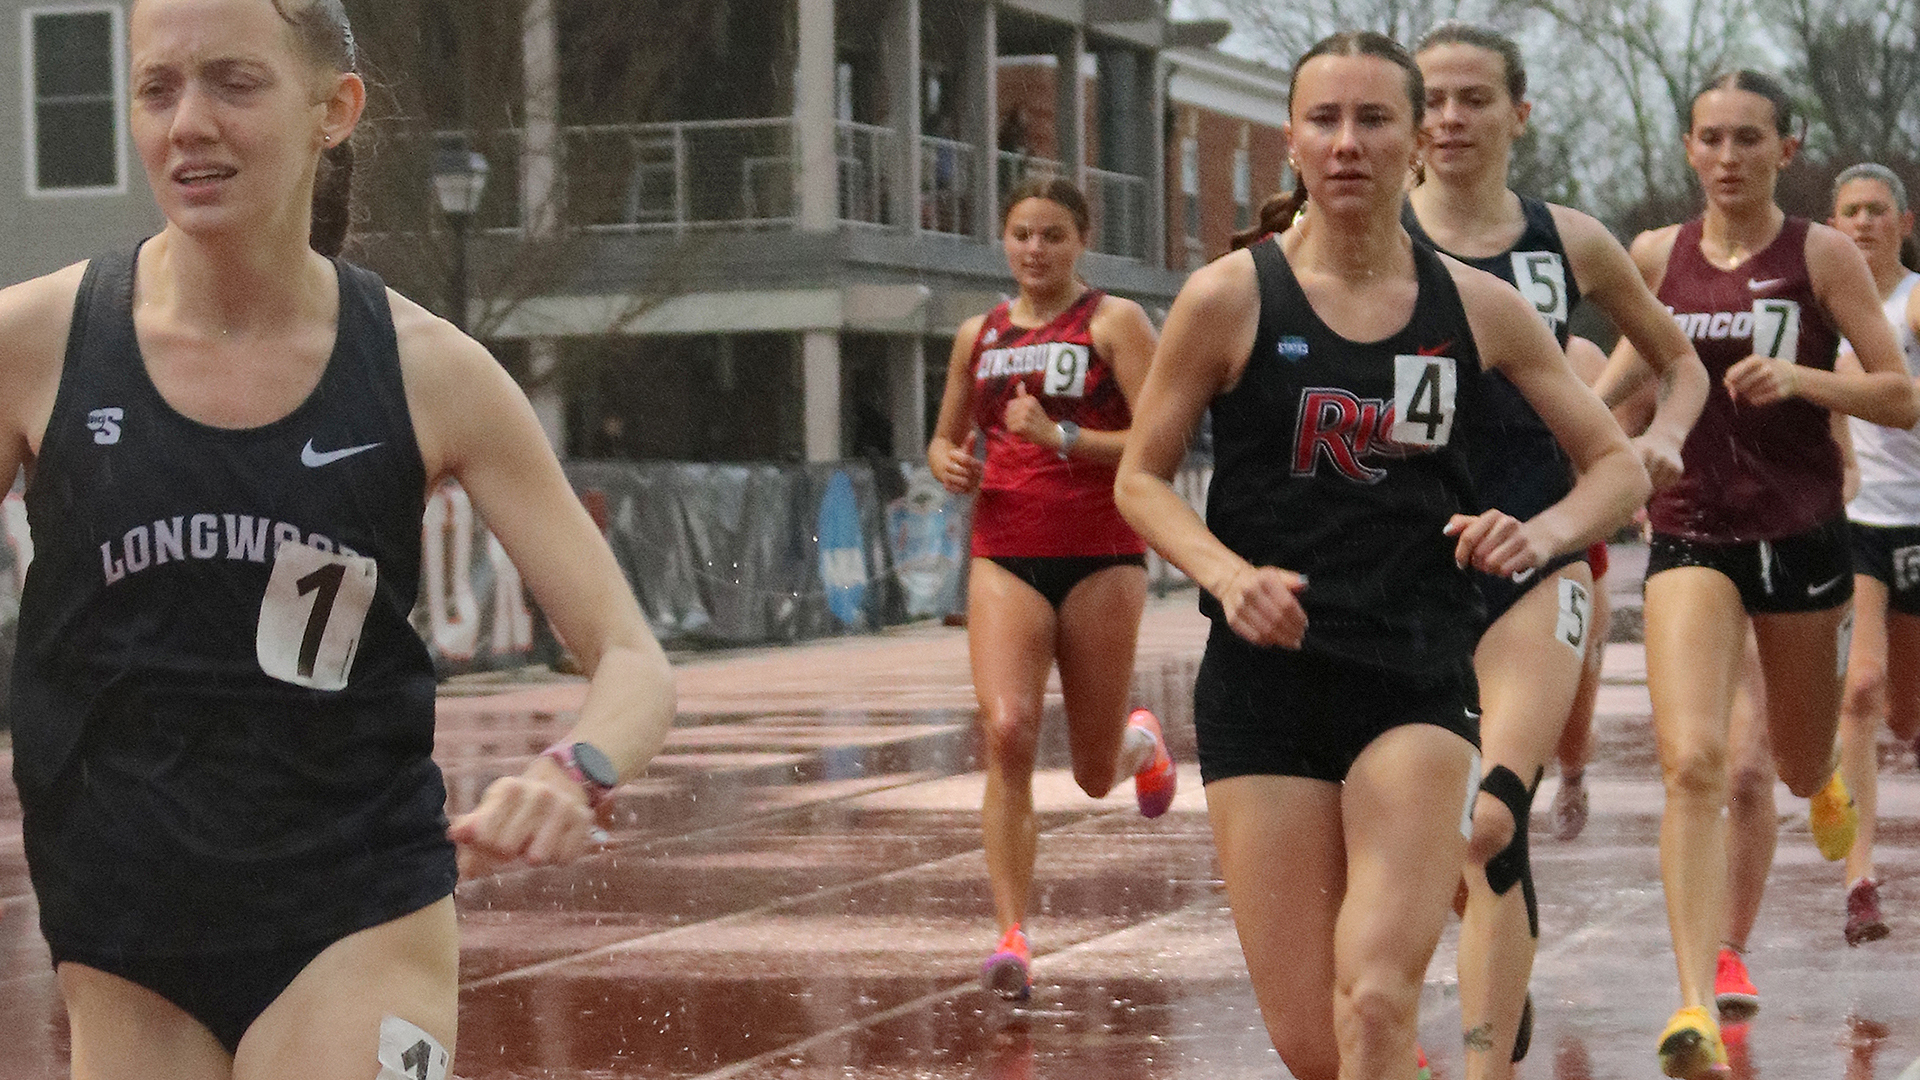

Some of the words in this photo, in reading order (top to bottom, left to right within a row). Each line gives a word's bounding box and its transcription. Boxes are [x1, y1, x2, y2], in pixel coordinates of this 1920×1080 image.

[1526, 256, 1558, 313] 5
[1765, 304, 1787, 358] 7
[1056, 349, 1077, 391] 9
[1406, 363, 1444, 440] 4
[1290, 387, 1396, 484] RI
[296, 562, 347, 679] 1
[1566, 583, 1586, 648] 5
